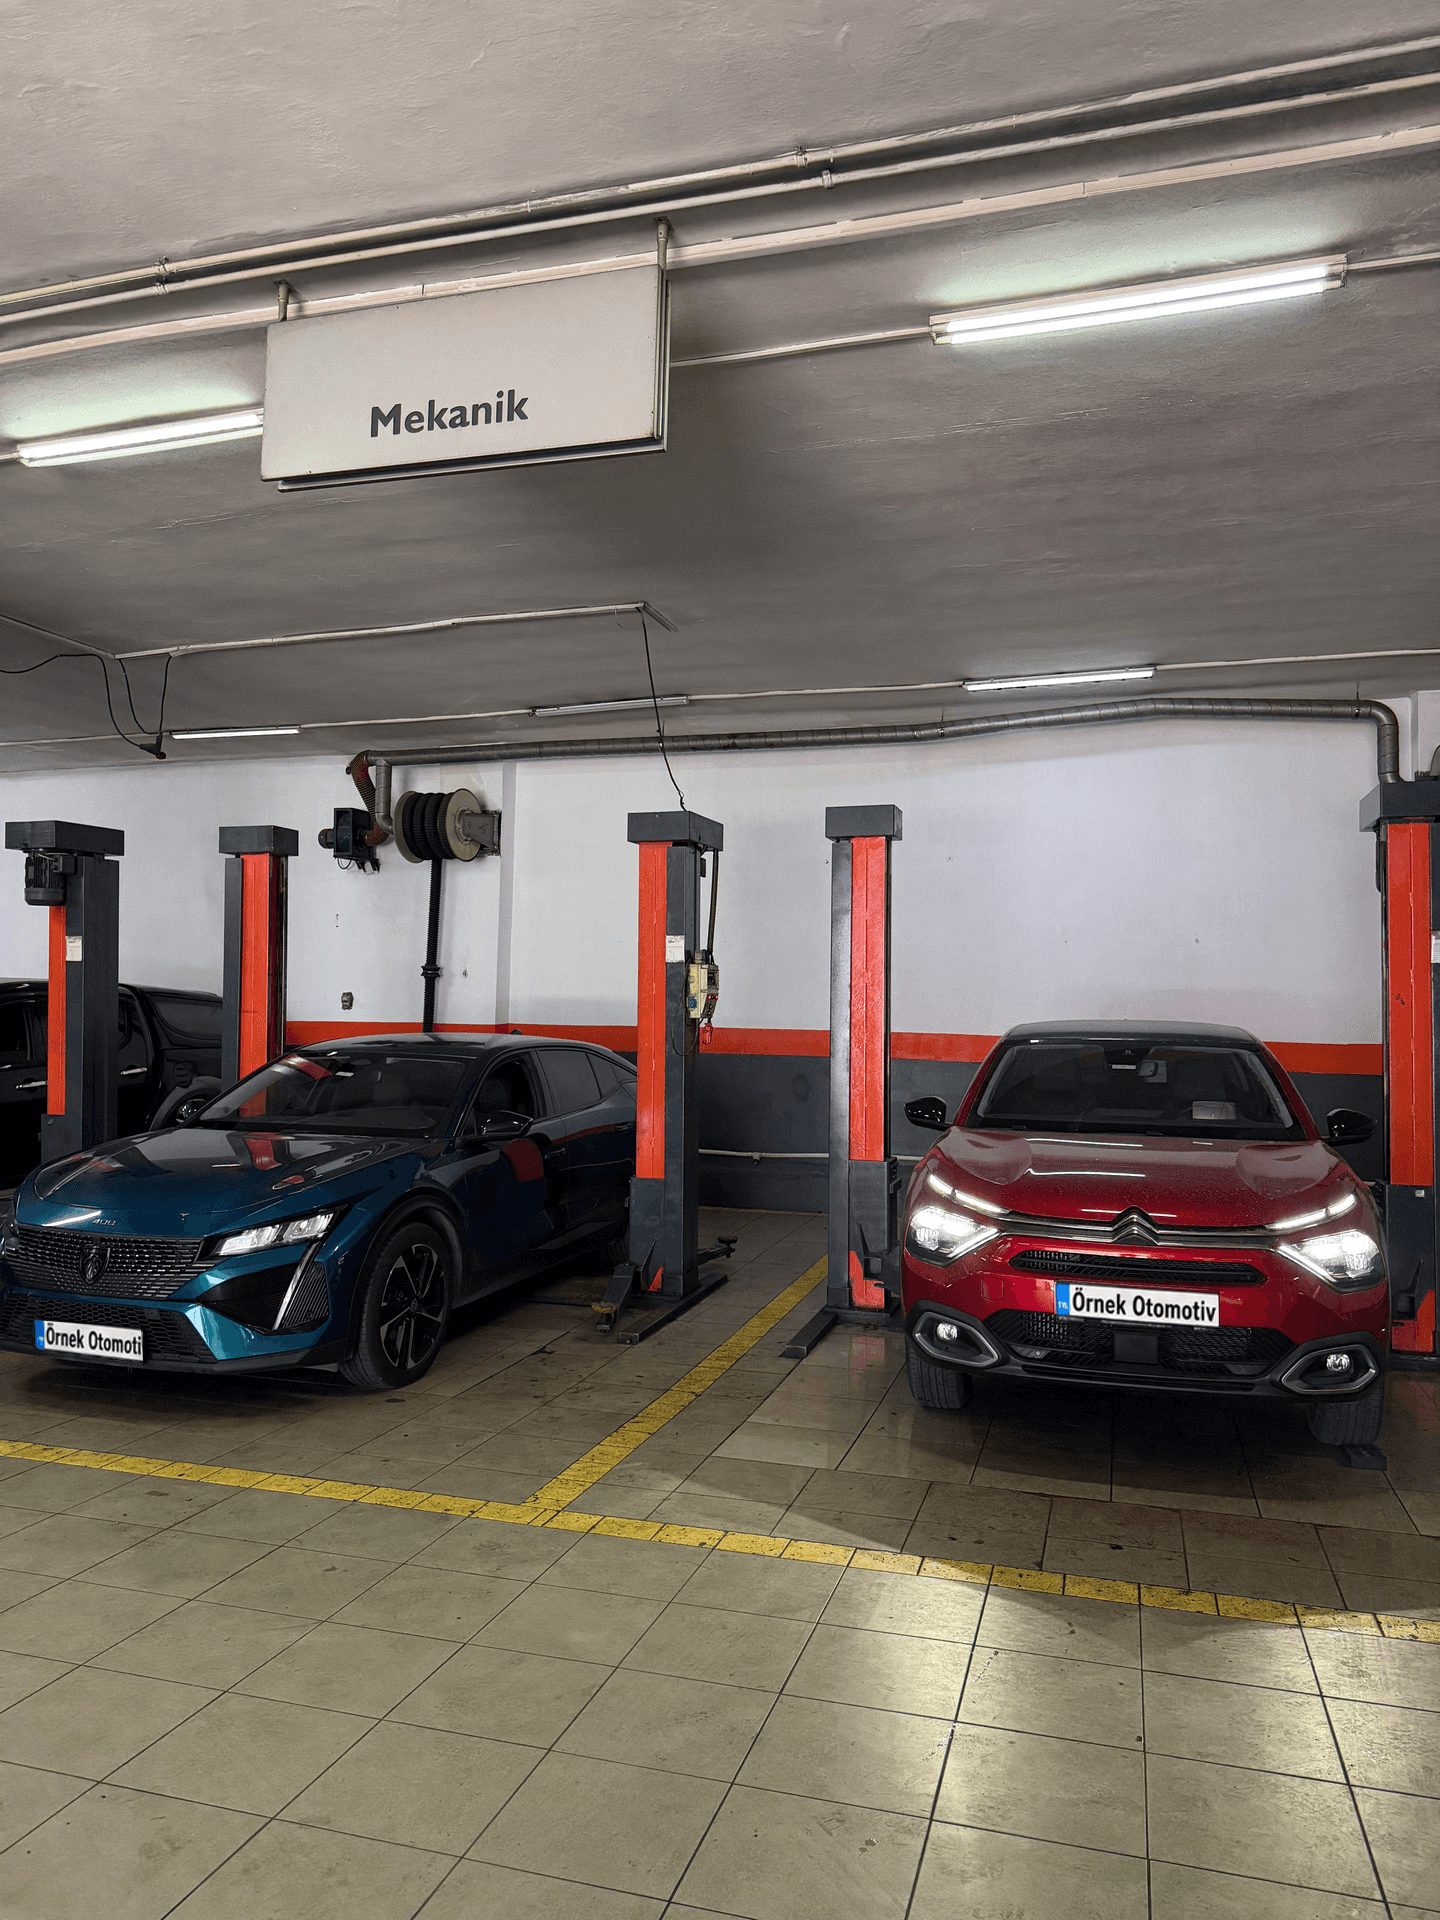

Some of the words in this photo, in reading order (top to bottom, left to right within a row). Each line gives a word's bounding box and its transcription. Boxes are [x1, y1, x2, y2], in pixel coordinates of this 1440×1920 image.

[370, 389, 529, 438] Mekanik
[1072, 1286, 1126, 1315] Örnek
[1132, 1295, 1216, 1322] Otomotiv
[45, 1322, 84, 1349] Örnek
